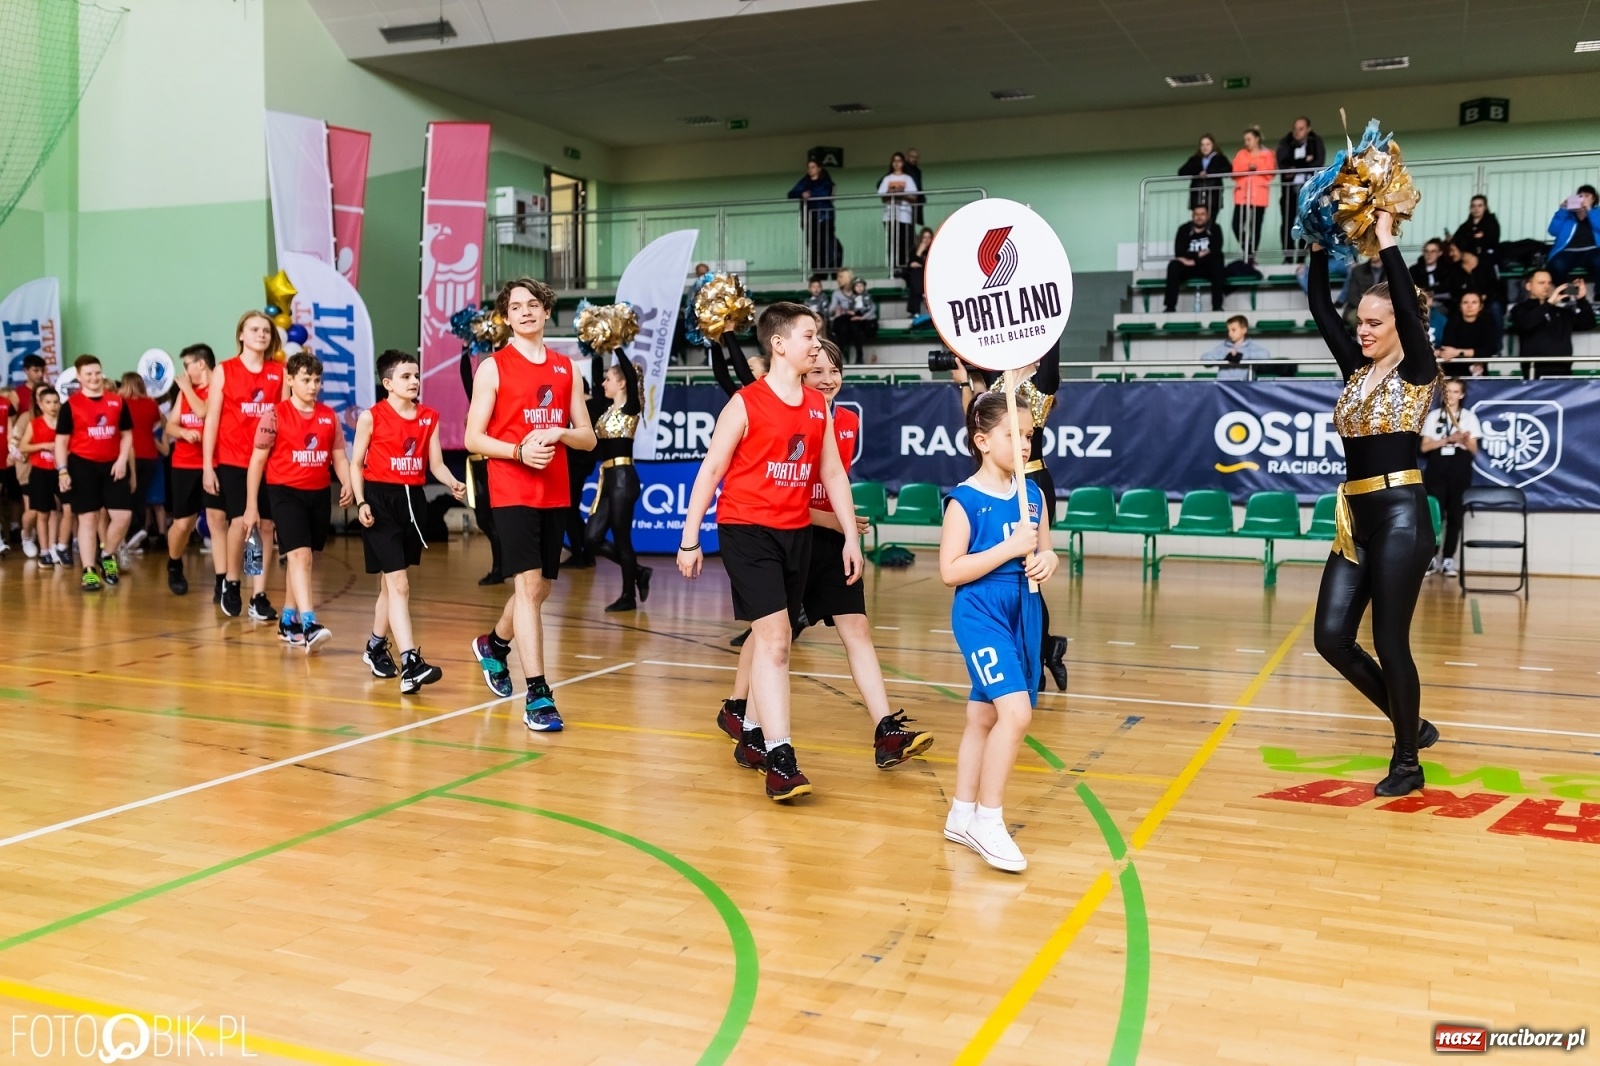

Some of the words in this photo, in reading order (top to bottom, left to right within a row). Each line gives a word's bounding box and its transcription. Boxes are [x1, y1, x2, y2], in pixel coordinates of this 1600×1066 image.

[1465, 108, 1479, 122] B
[1490, 106, 1503, 119] B
[823, 154, 838, 165] A
[947, 282, 1062, 337] PORTLAND
[651, 309, 672, 378] RACIBÓRZ
[978, 333, 1005, 347] TRAIL
[1008, 325, 1046, 341] BLAZERS
[656, 411, 715, 449] SiR
[765, 461, 812, 480] PORTLAN
[638, 519, 652, 529] the
[971, 646, 1004, 687] 12
